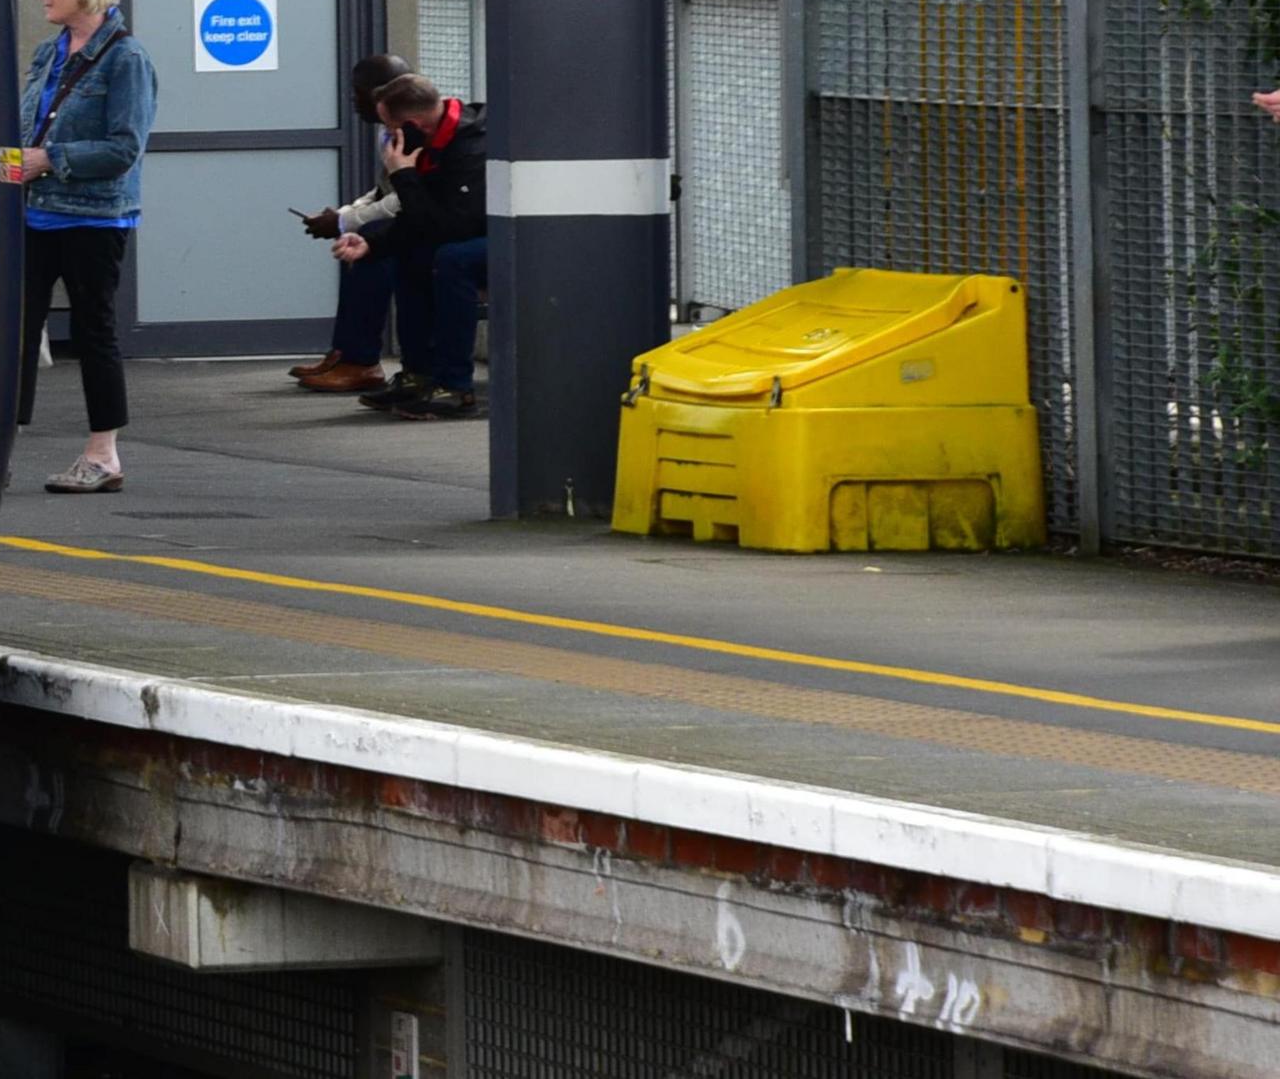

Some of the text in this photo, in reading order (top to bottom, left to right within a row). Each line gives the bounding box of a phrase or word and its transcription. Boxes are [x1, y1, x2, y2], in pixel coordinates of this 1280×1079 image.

[210, 13, 261, 27] Fire exit
[204, 29, 269, 45] keep clear
